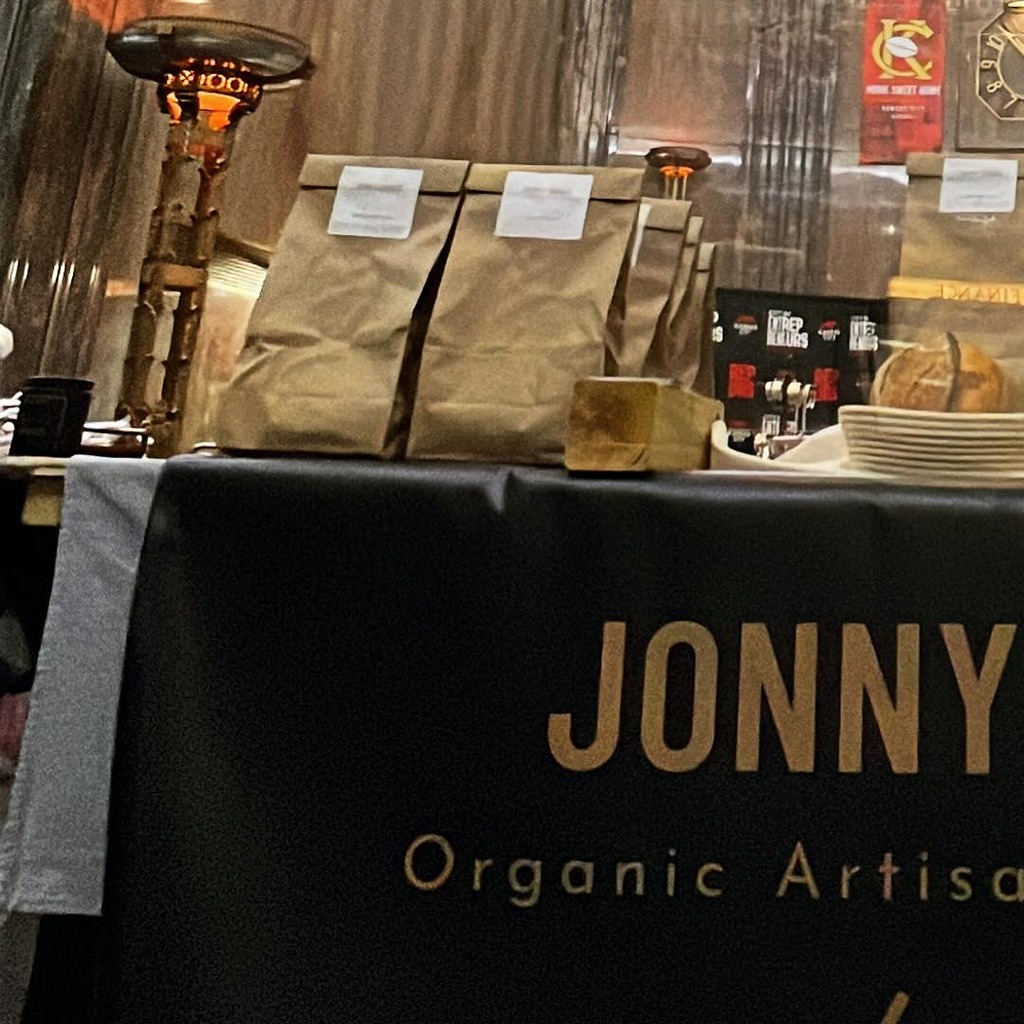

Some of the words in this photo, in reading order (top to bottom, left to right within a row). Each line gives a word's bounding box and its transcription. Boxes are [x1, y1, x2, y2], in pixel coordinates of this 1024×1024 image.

[980, 59, 999, 70] 9
[986, 80, 1004, 94] 8
[547, 620, 1018, 775] JONNY
[402, 833, 726, 908] Organic
